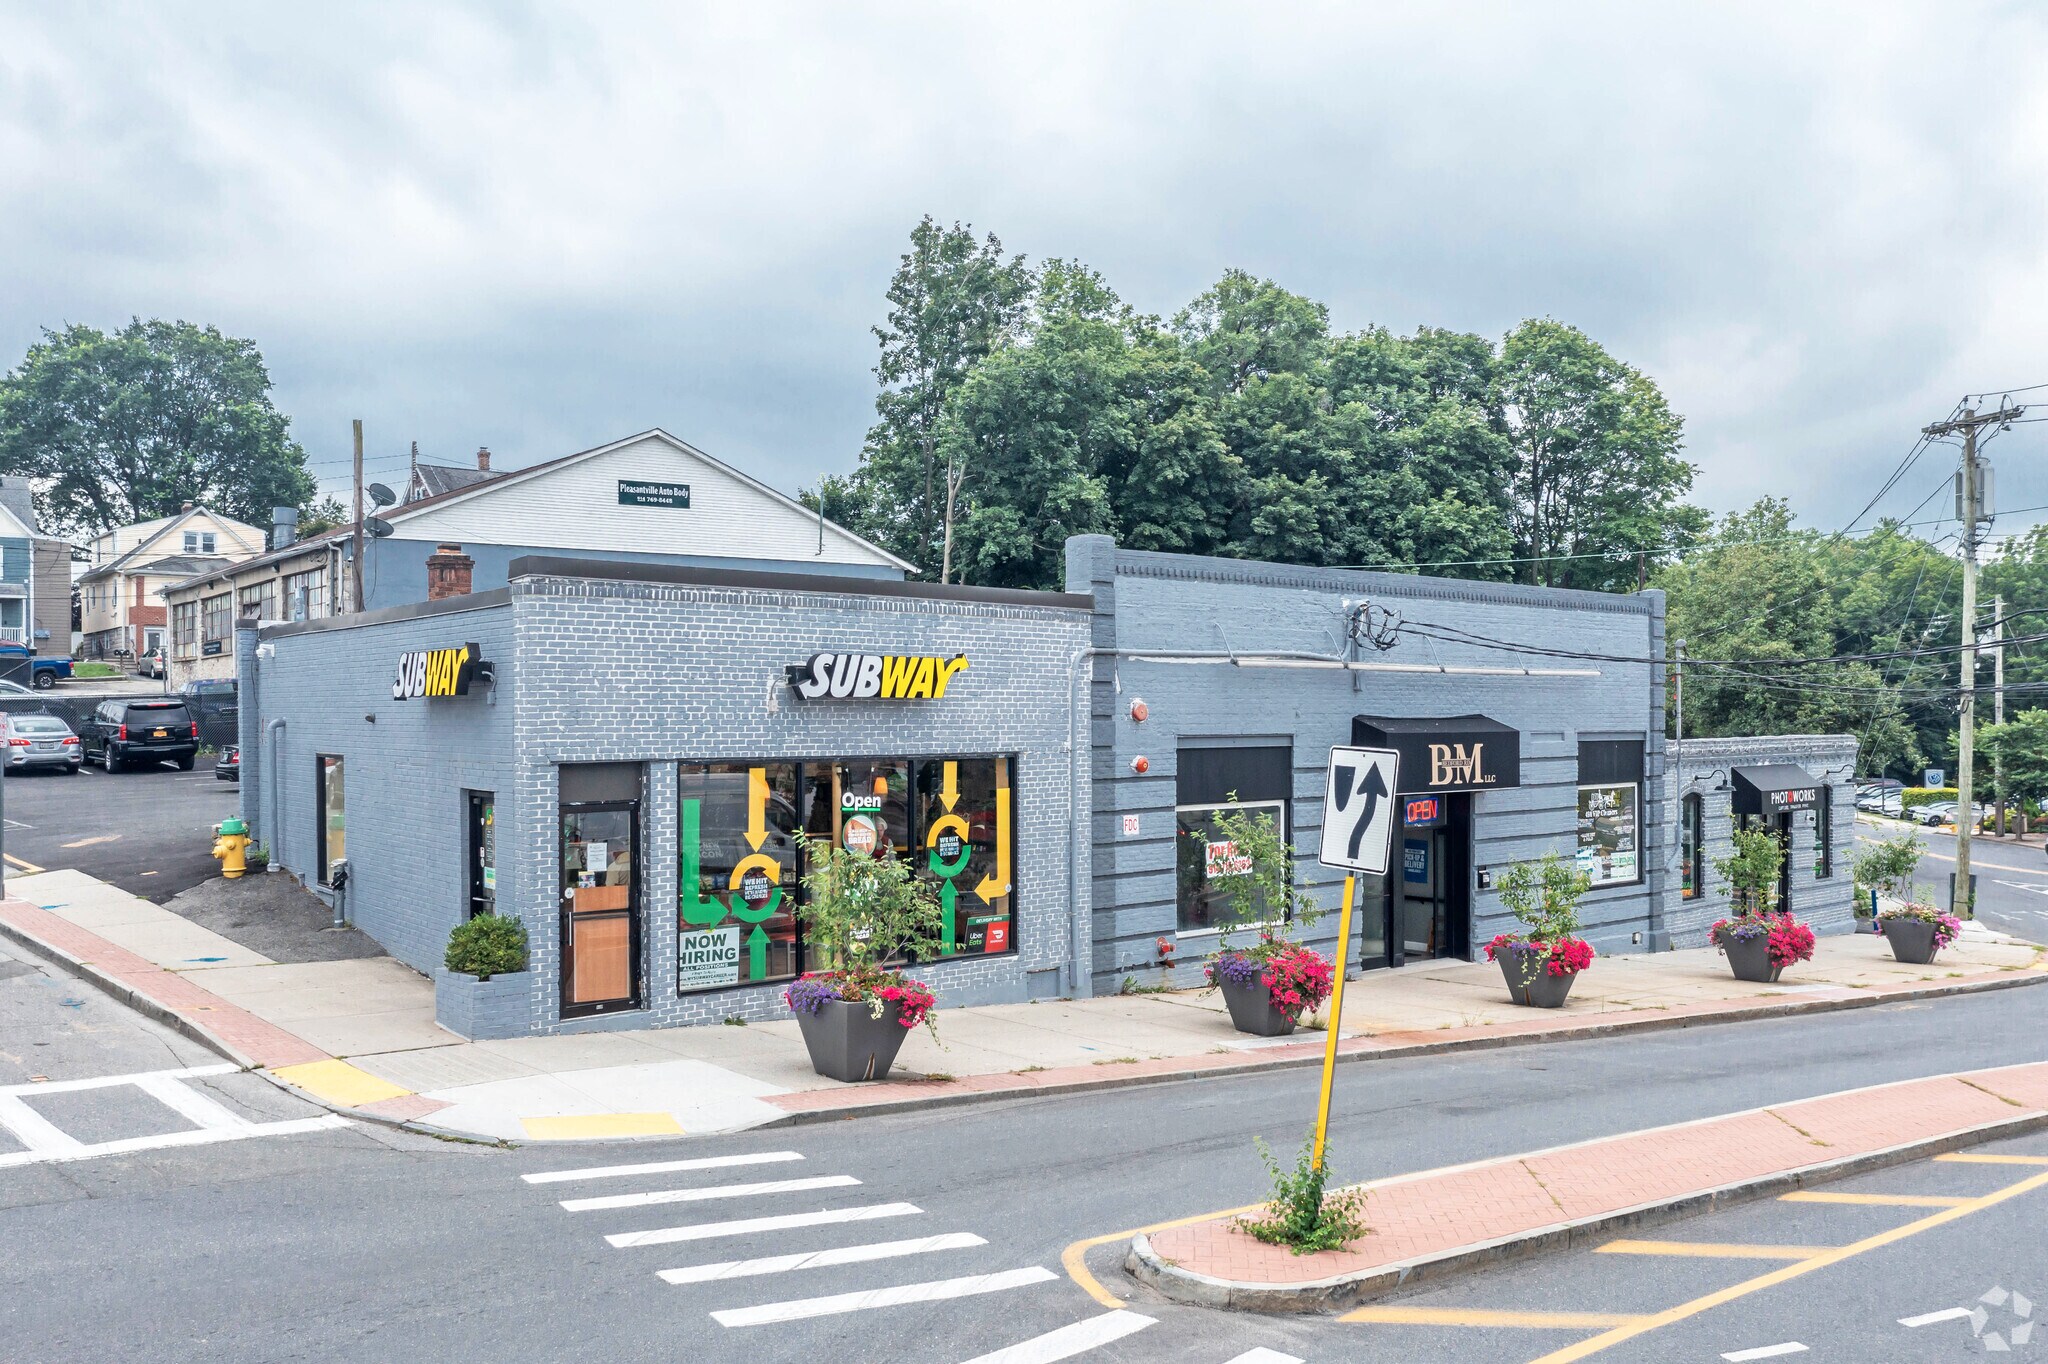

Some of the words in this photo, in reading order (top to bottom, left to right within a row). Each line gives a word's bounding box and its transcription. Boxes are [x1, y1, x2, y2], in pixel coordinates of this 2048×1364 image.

[620, 484, 658, 494] Pleasantville
[659, 486, 673, 496] Auto
[674, 487, 689, 499] Body
[392, 645, 469, 698] SUBWAY
[799, 653, 971, 700] SUBWAY
[1484, 775, 1496, 783] LLC
[842, 791, 881, 811] Open
[1771, 789, 1816, 805] PHOTOWORKS
[1407, 799, 1437, 822] OPEN
[1124, 818, 1138, 831] FDC
[848, 836, 872, 845] BREAD
[1404, 861, 1425, 869] DELIVERY
[745, 878, 755, 886] WE
[756, 877, 768, 885] HIT
[685, 933, 727, 950] NOW
[970, 932, 983, 940] Uber
[695, 962, 729, 971] POSITIONS
